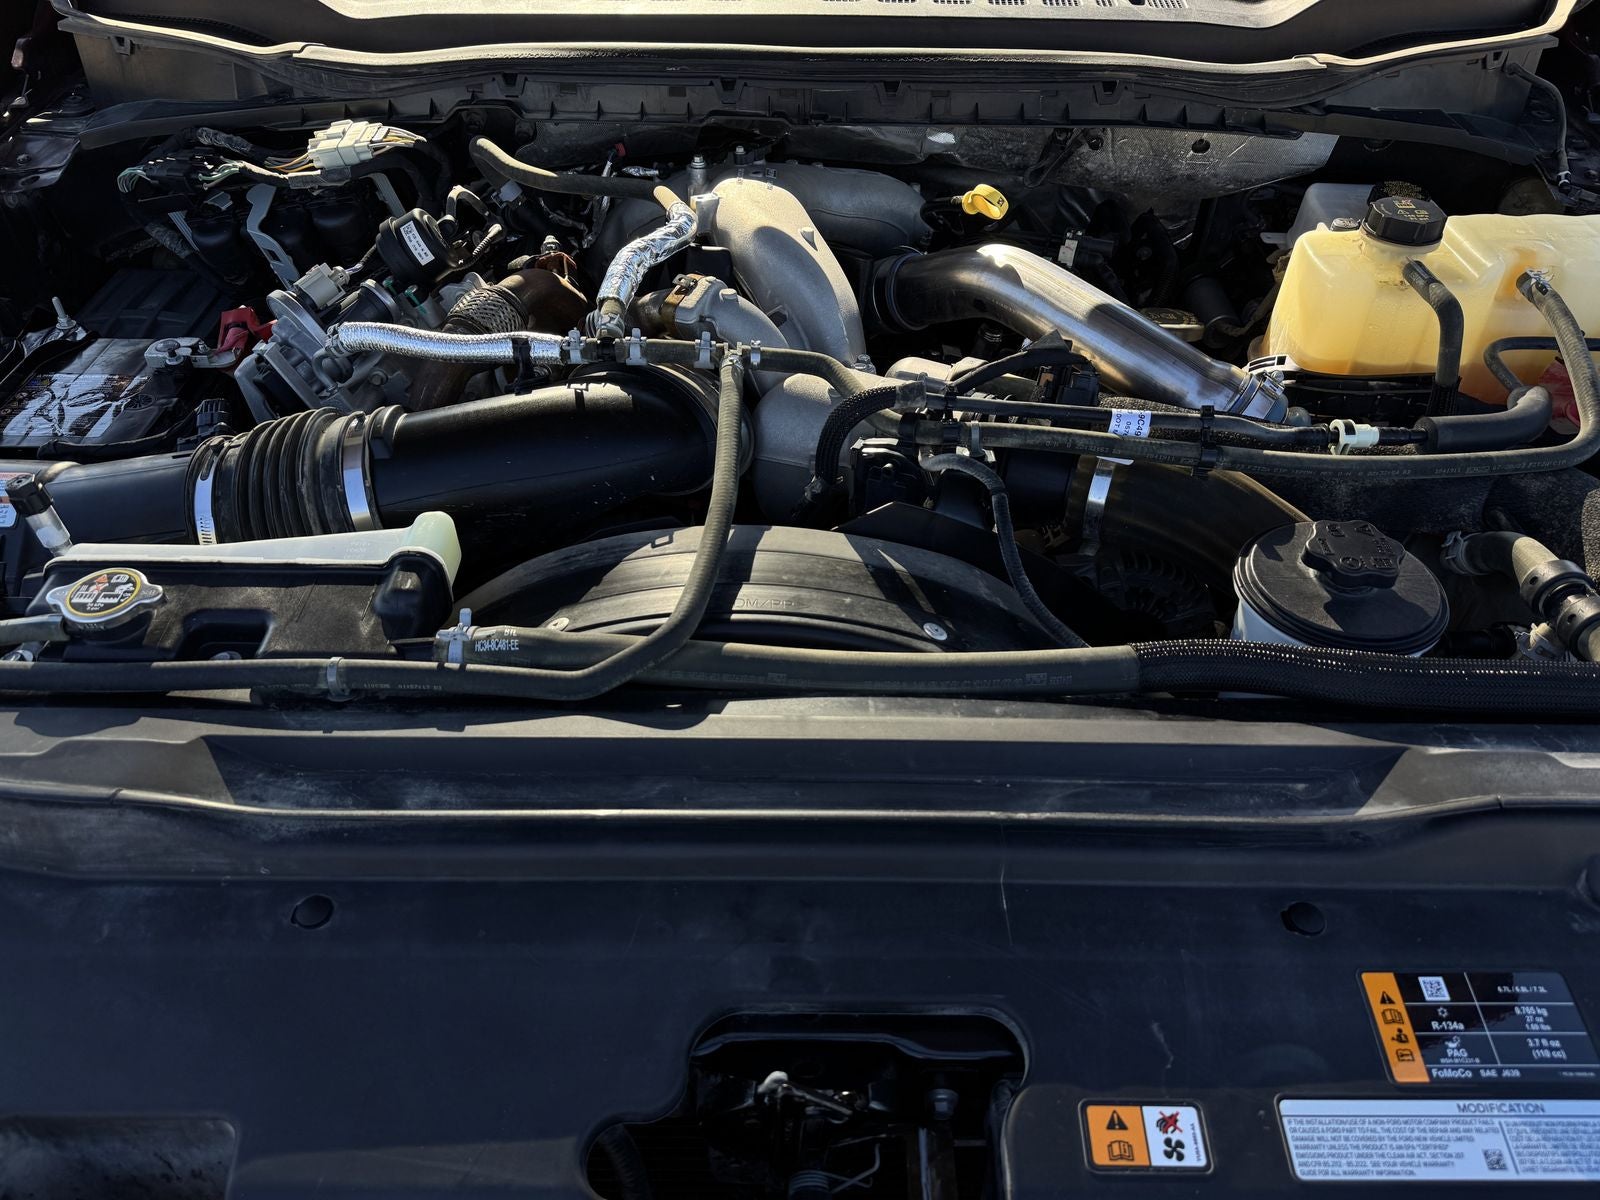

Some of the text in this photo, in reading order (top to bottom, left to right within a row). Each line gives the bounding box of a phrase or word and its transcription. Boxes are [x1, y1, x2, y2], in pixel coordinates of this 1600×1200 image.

[1537, 1006, 1548, 1017] kg
[1431, 1021, 1465, 1030] R-134a
[1526, 1038, 1540, 1047] 3.7
[1447, 1049, 1468, 1057] PAG
[1552, 1050, 1567, 1059] cc)
[1432, 1069, 1472, 1078] FoMoCo
[1457, 1103, 1546, 1113] MODIFICATION
